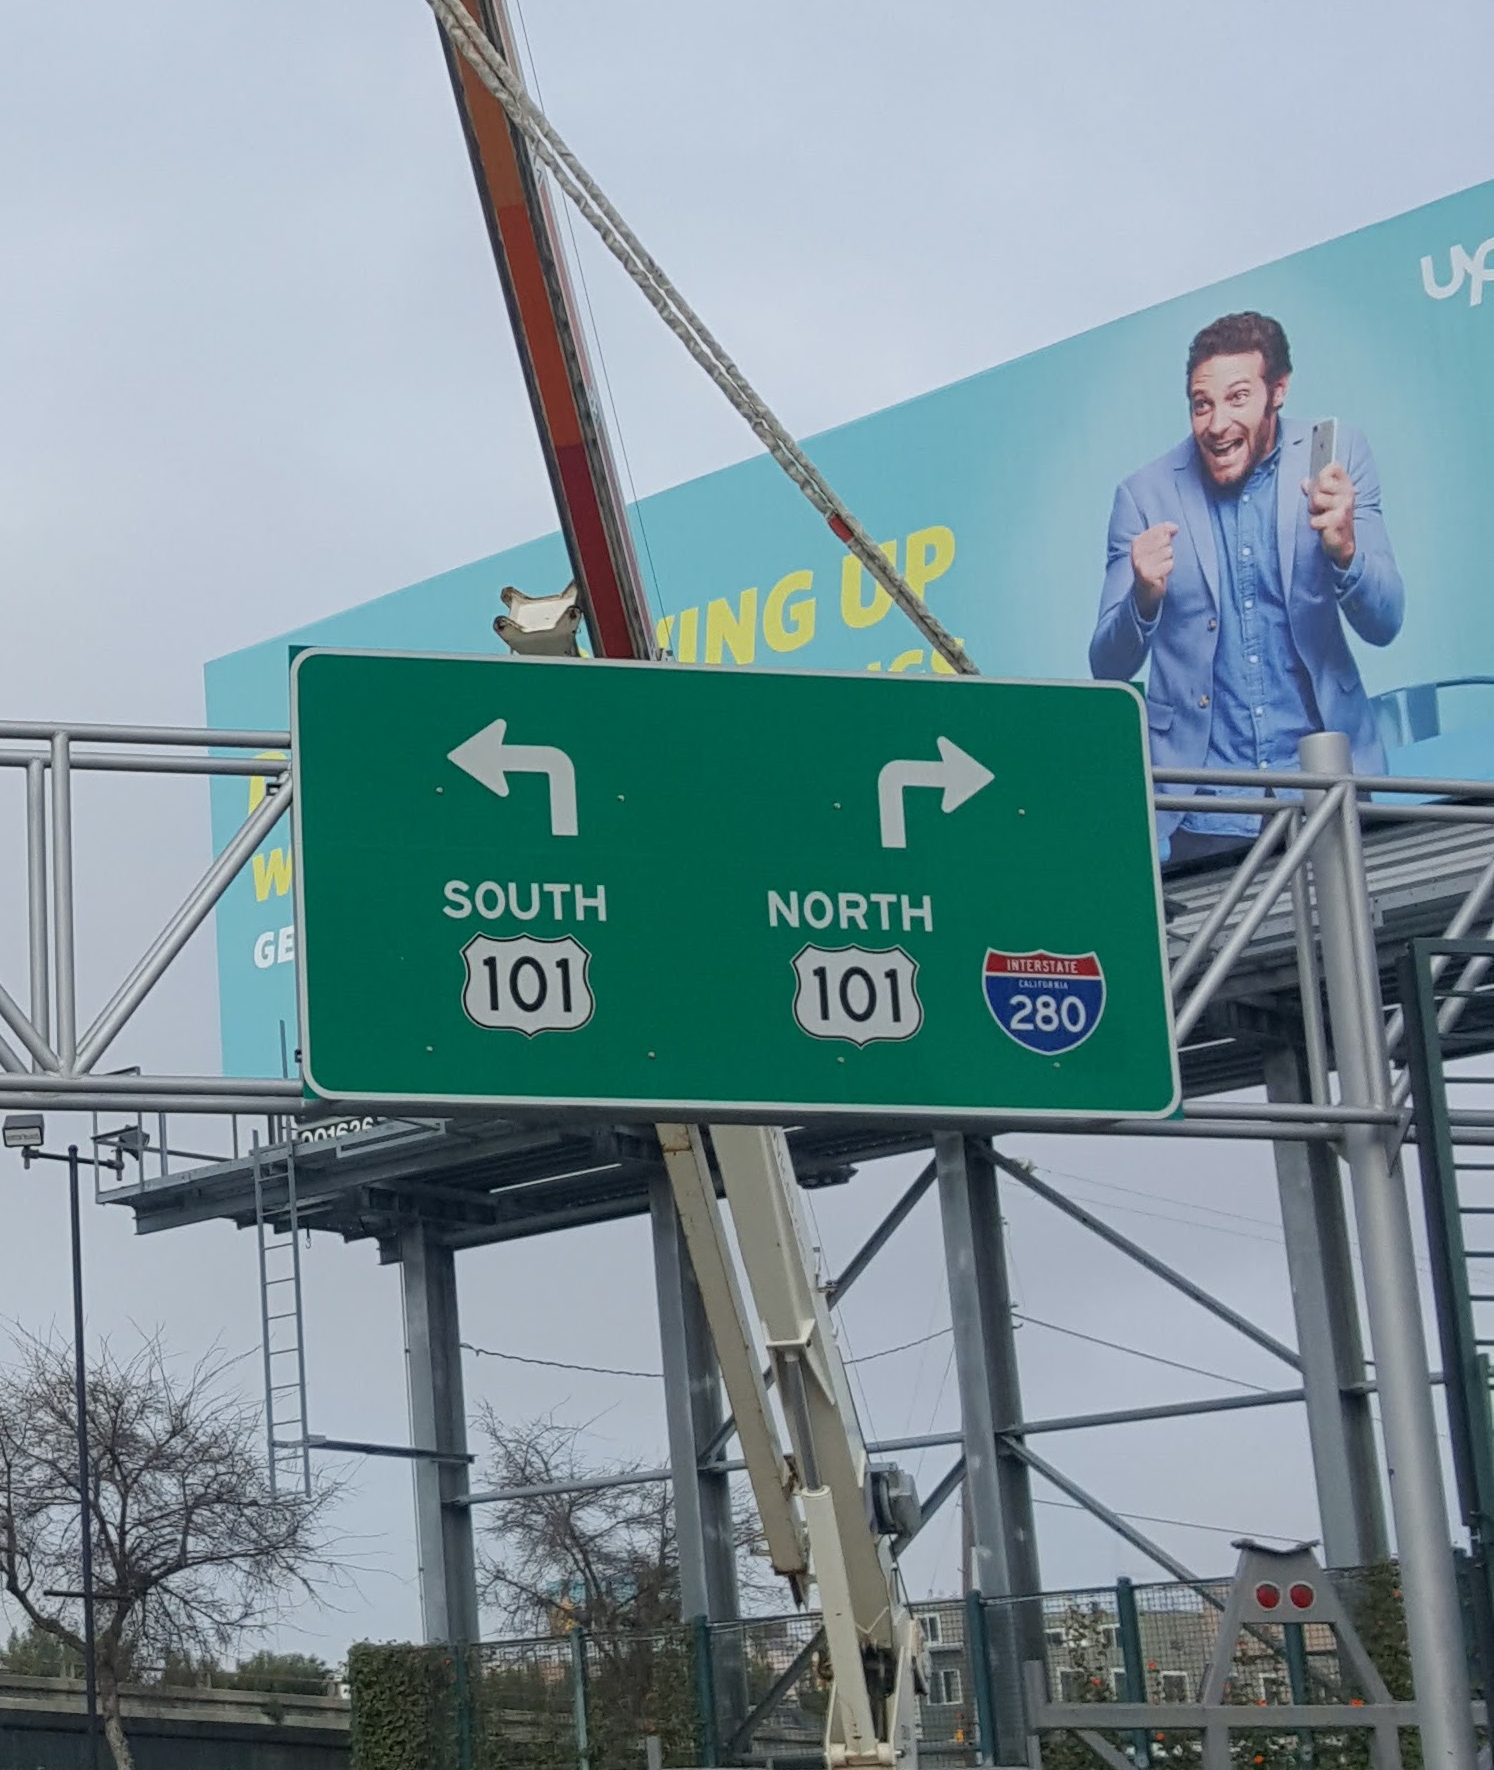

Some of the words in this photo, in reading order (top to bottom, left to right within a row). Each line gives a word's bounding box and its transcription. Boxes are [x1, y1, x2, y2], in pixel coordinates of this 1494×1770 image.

[841, 525, 956, 629] UP
[442, 880, 607, 922] SOUTH
[767, 890, 934, 932] NORTH
[482, 954, 574, 1013] 101
[1006, 958, 1079, 974] INTERSTATE
[1018, 979, 1069, 990] CALIFORNIA
[812, 965, 902, 1024] 101
[1009, 994, 1087, 1033] 280
